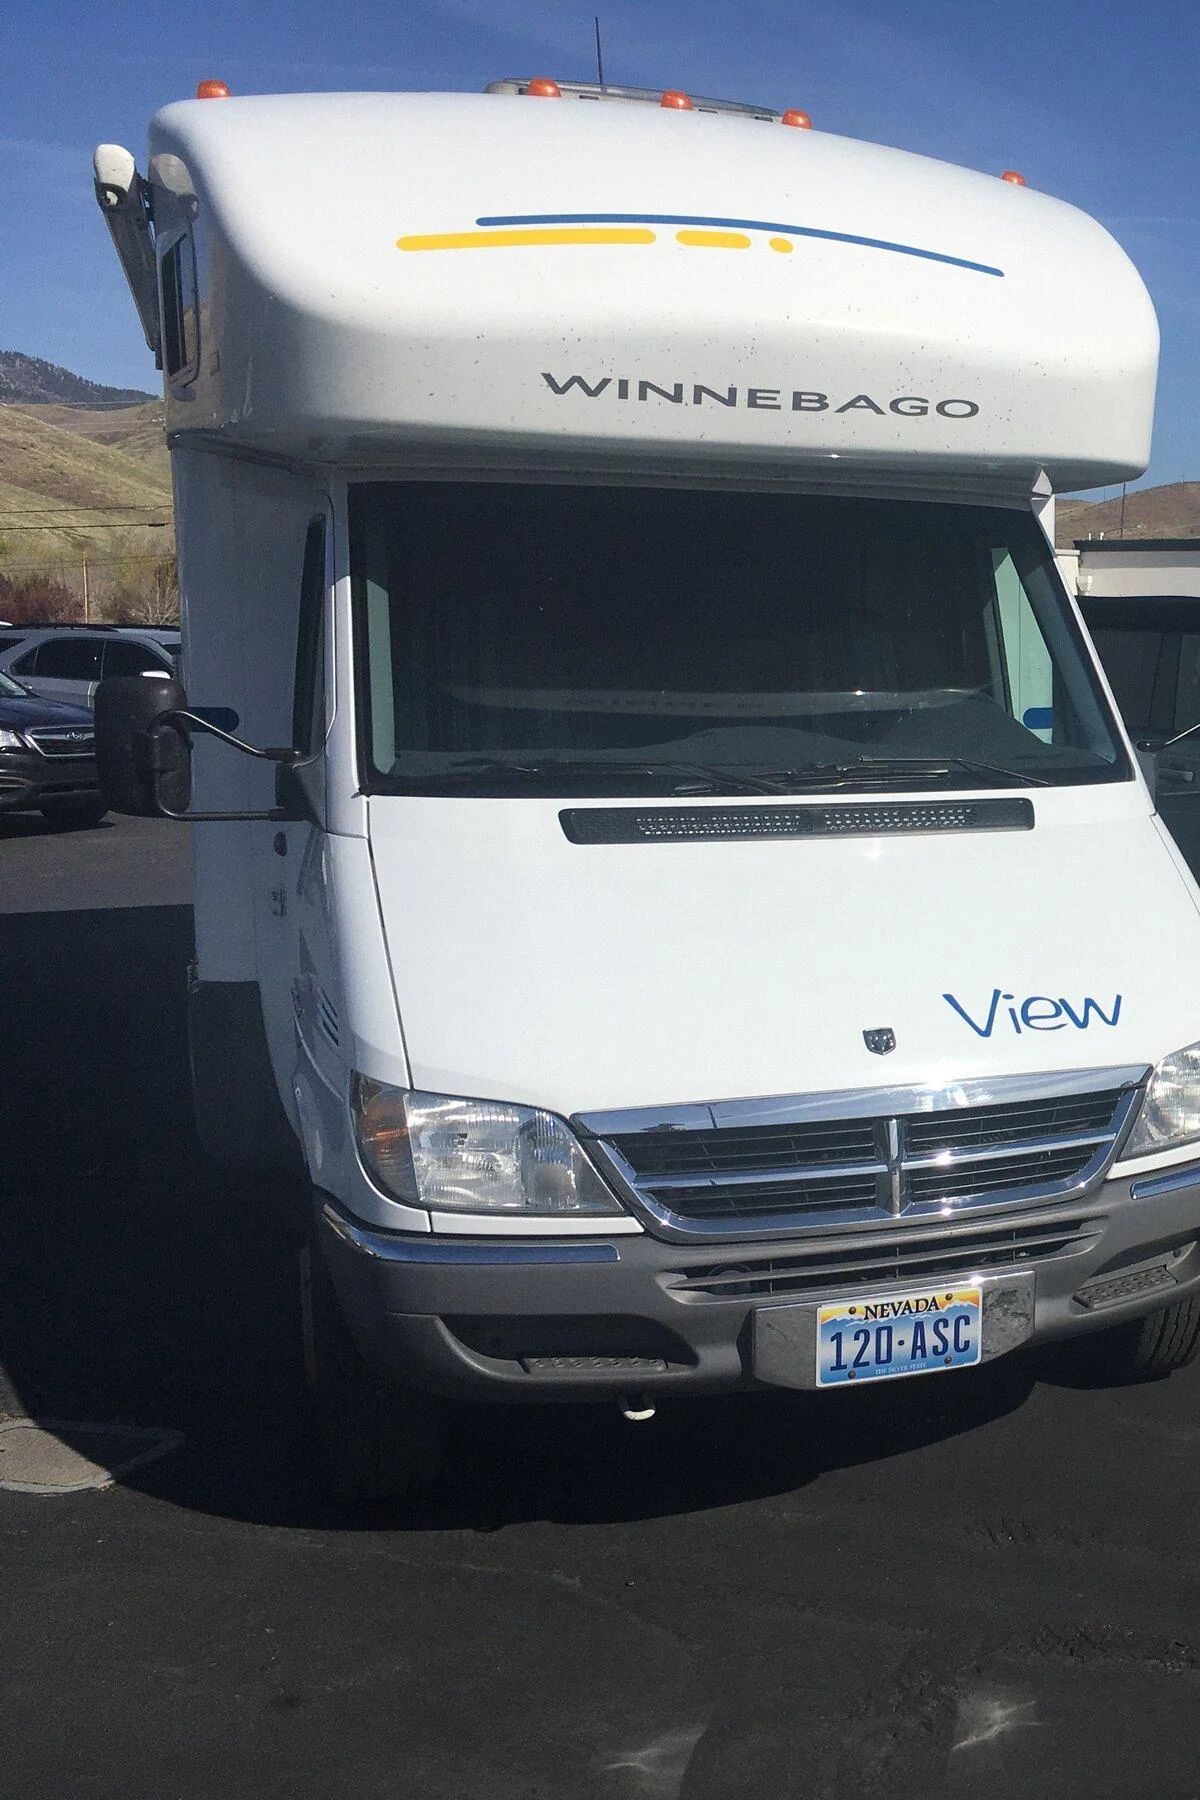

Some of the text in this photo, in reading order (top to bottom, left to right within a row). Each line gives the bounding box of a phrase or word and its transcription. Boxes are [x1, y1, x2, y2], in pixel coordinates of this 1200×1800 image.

[540, 371, 980, 419] WINNEBAGO
[942, 988, 1122, 1038] View
[864, 1296, 940, 1320] NEVADA
